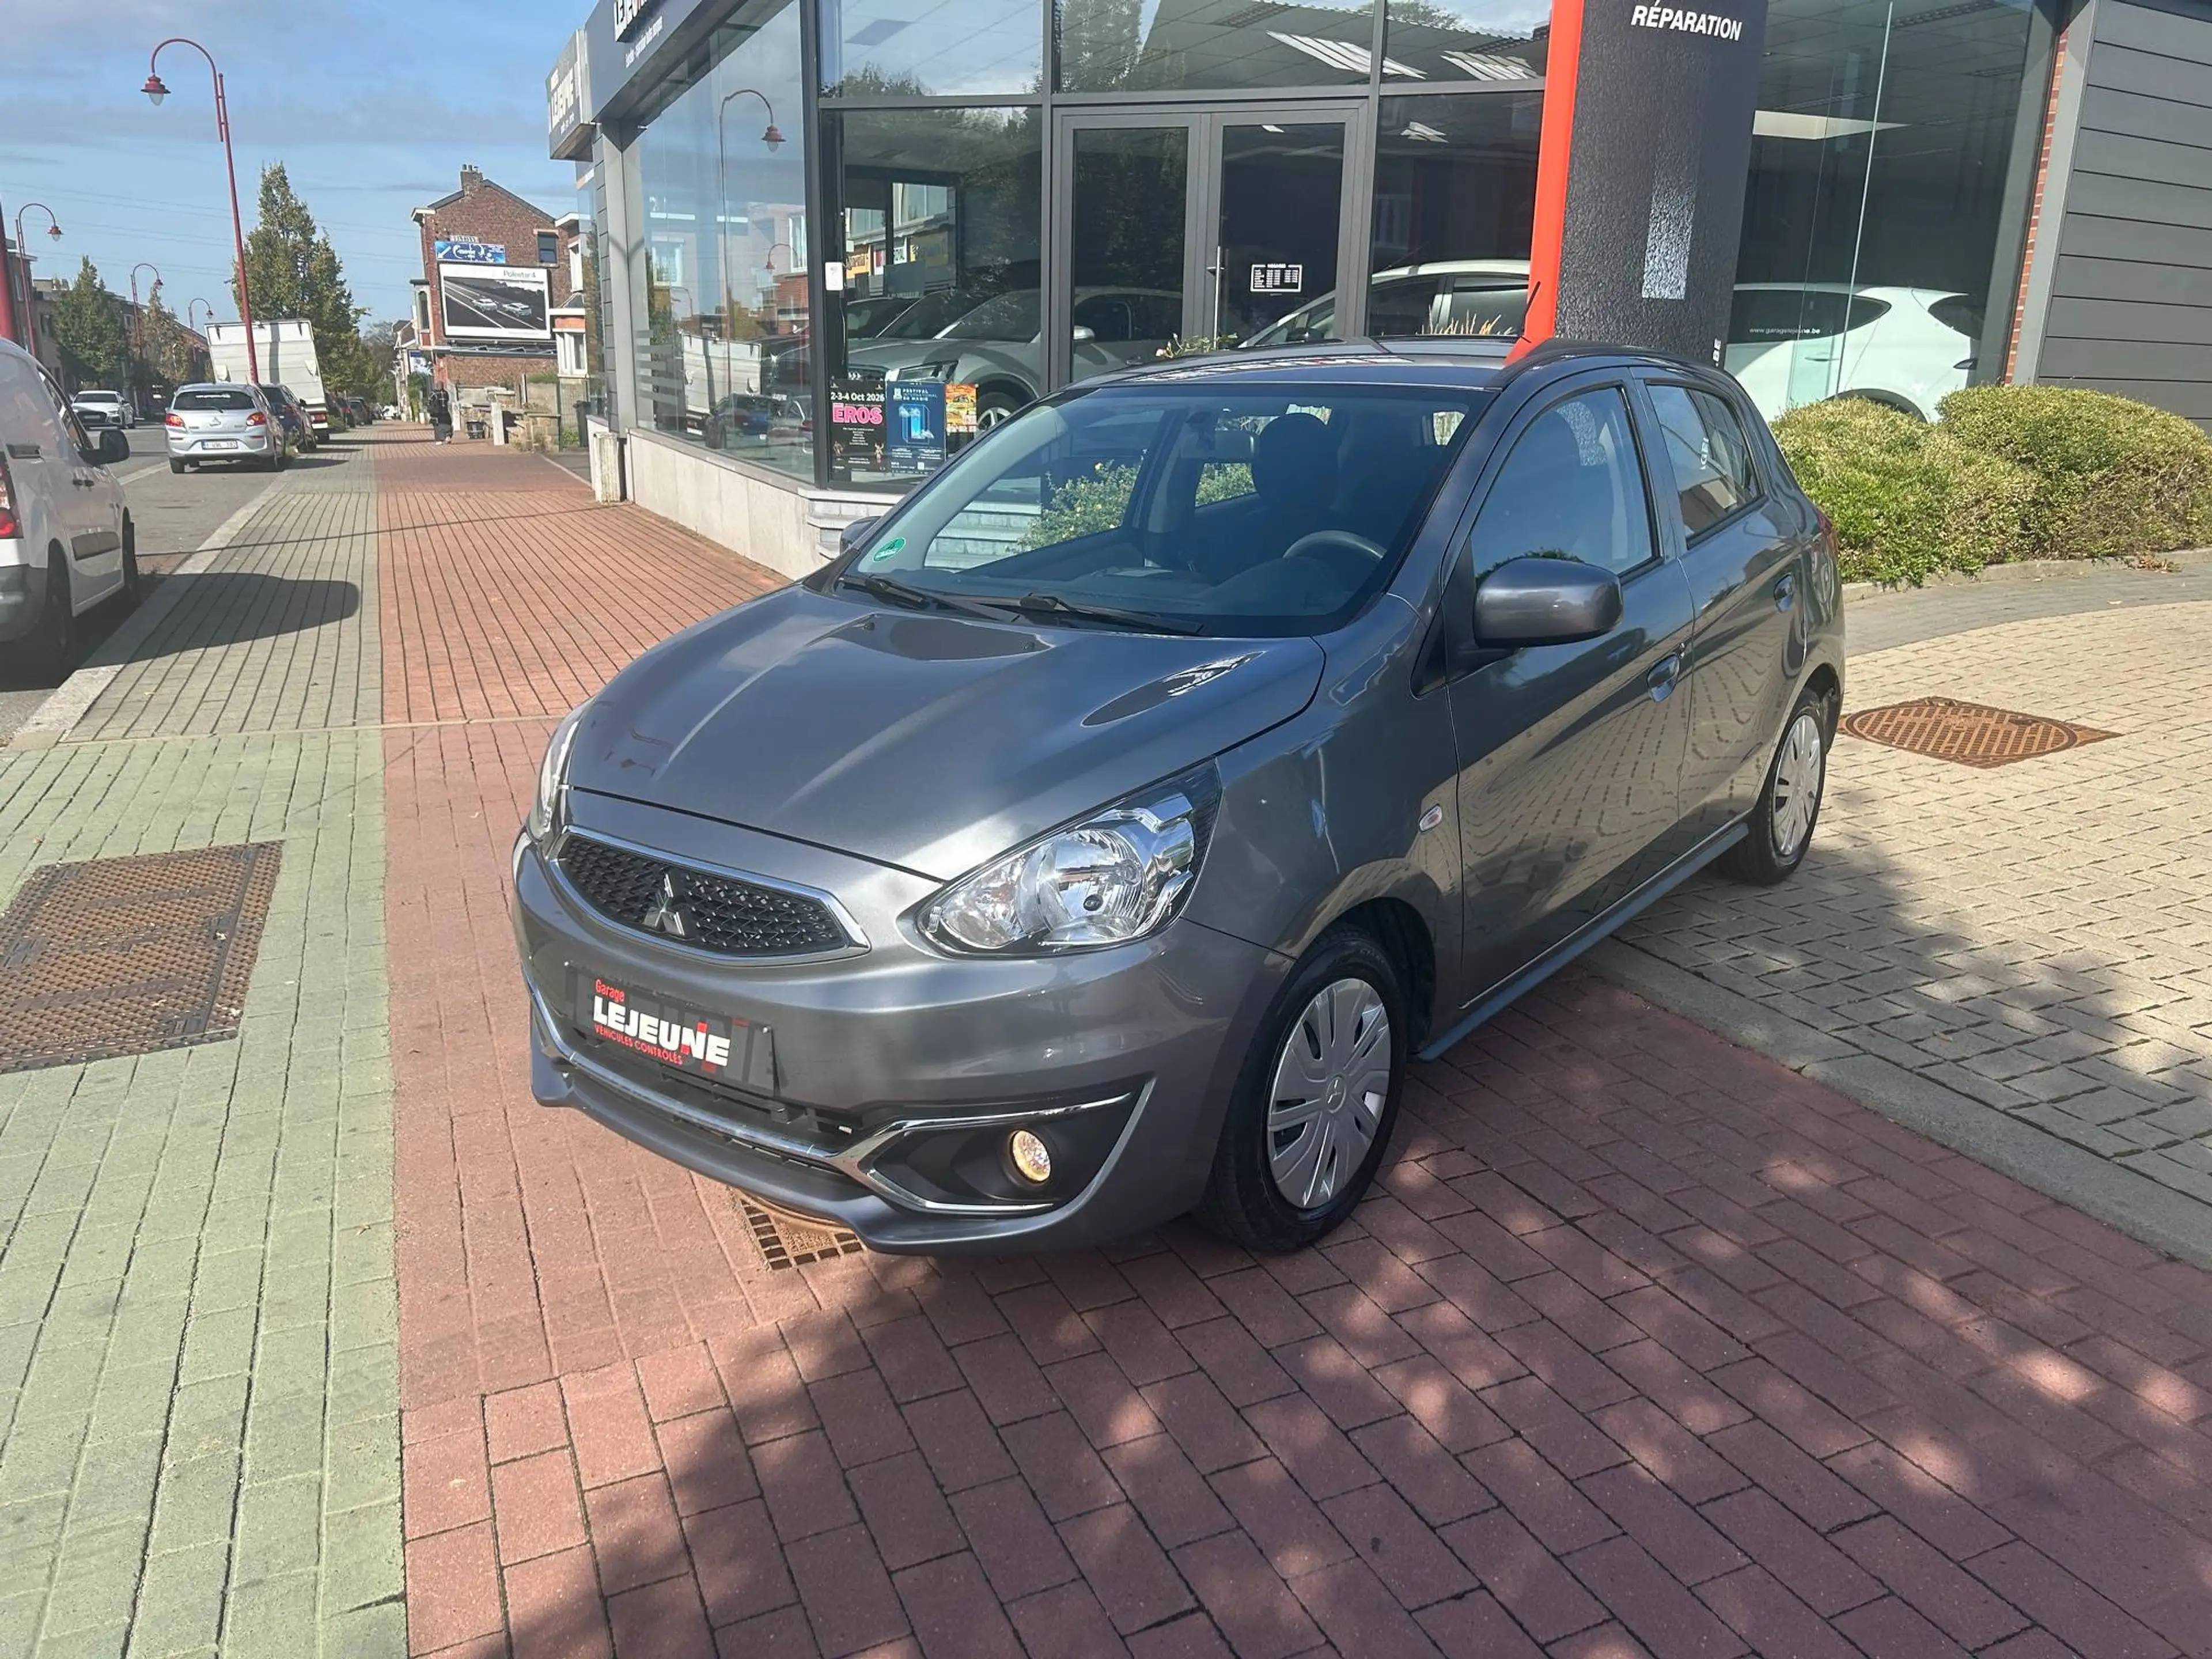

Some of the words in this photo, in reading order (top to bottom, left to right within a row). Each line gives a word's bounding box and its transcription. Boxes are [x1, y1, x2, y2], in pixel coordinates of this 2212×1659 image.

[1631, 0, 1742, 41] RÉPARATION
[830, 392, 850, 400] 2-3-4
[851, 393, 865, 401] Oct
[833, 403, 882, 424] EROS
[596, 979, 625, 1002] Garage
[593, 995, 730, 1066] LEJEUNE
